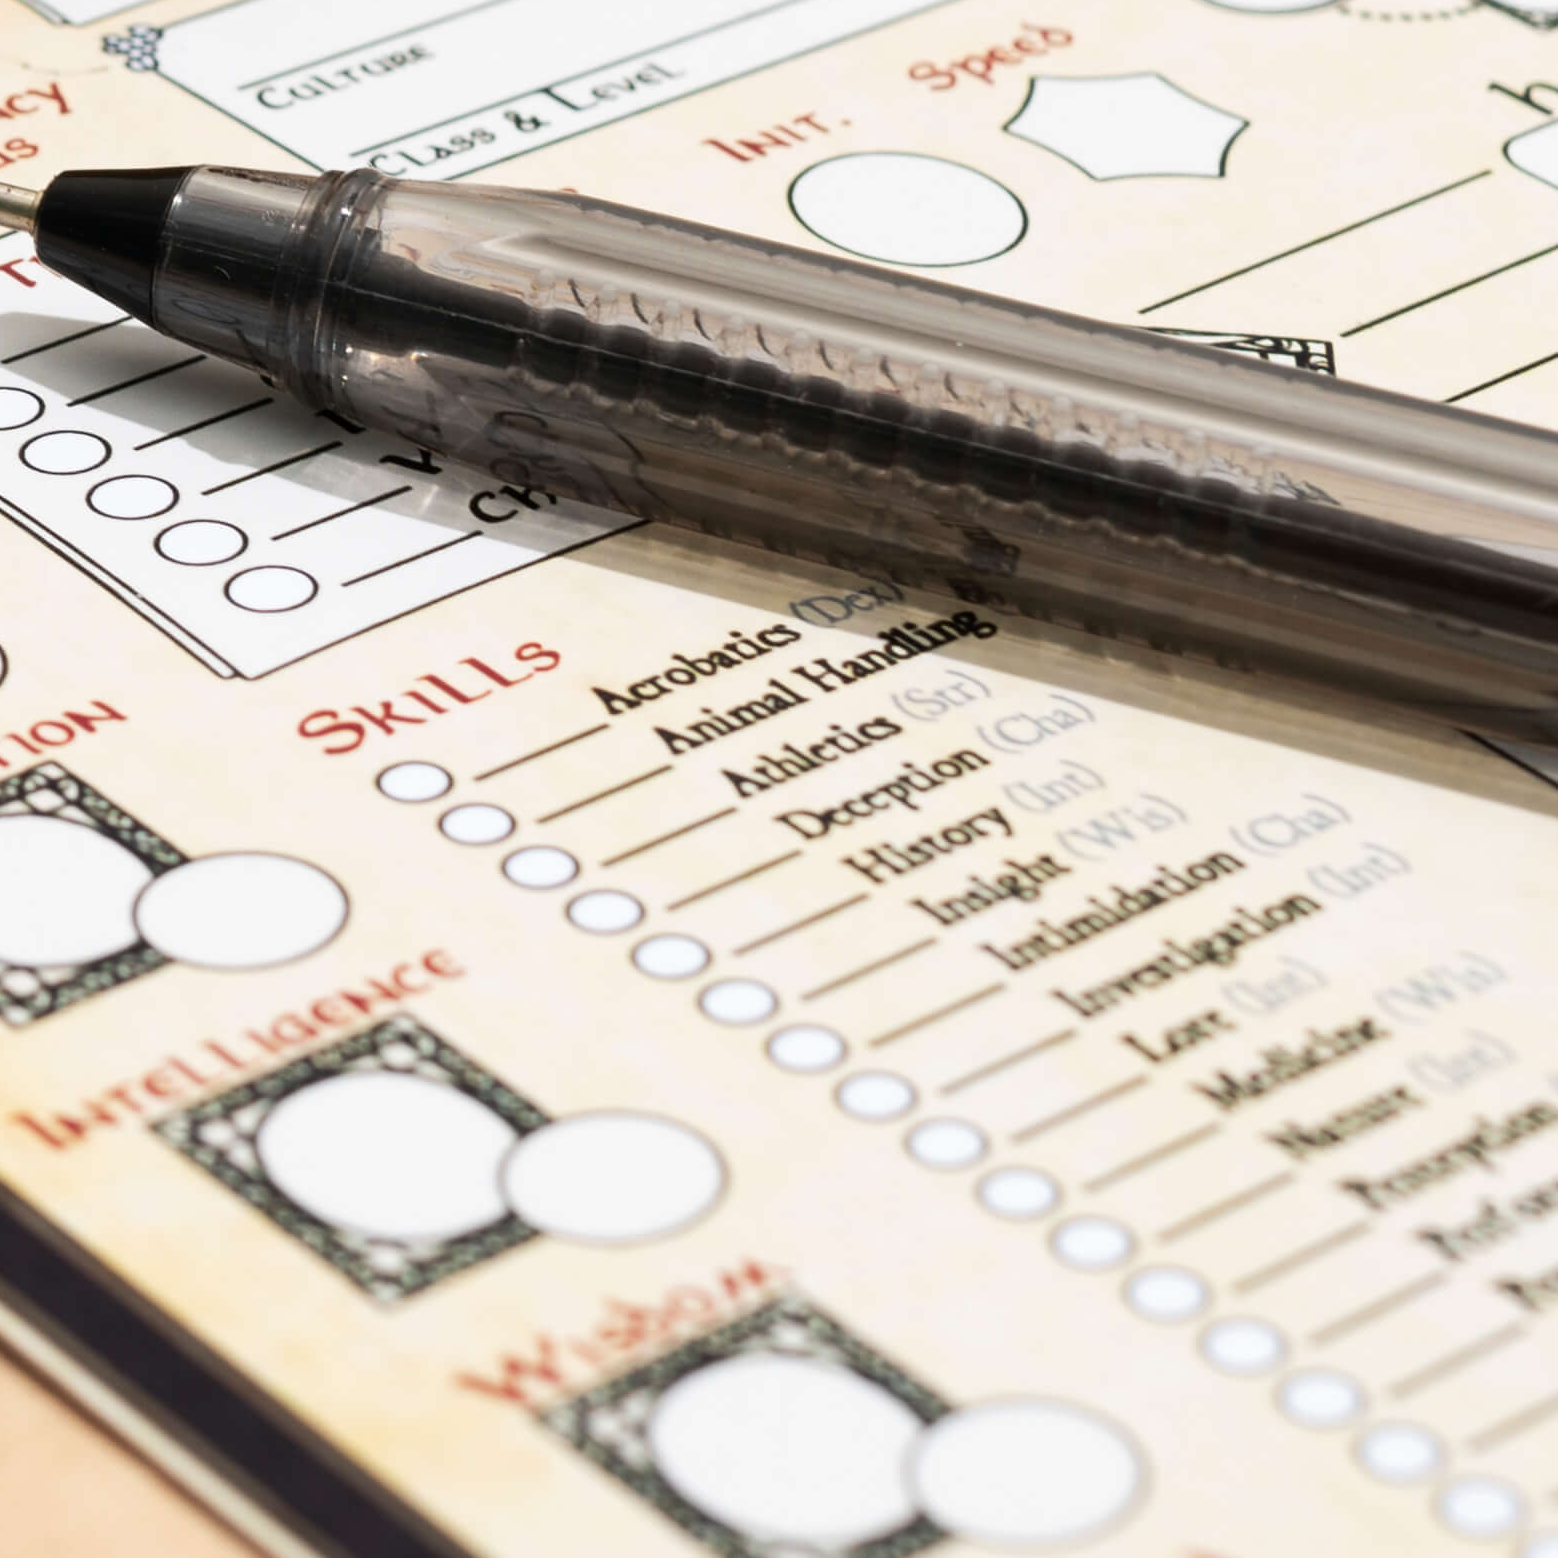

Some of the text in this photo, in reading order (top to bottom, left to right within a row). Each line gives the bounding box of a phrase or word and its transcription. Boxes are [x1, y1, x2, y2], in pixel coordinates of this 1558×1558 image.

[502, 110, 549, 133] &
[590, 576, 906, 718] Acrobatics (Dex)
[652, 606, 998, 757] Animal Handling
[720, 669, 992, 801] Athletics (Str)
[772, 693, 1098, 842] Deception (Cha)
[840, 758, 1106, 887] History (Int)
[910, 792, 1189, 928] Insight (Wis)
[981, 794, 1354, 974] Intimidation (Cha)
[1049, 890, 1324, 1021] Investigation
